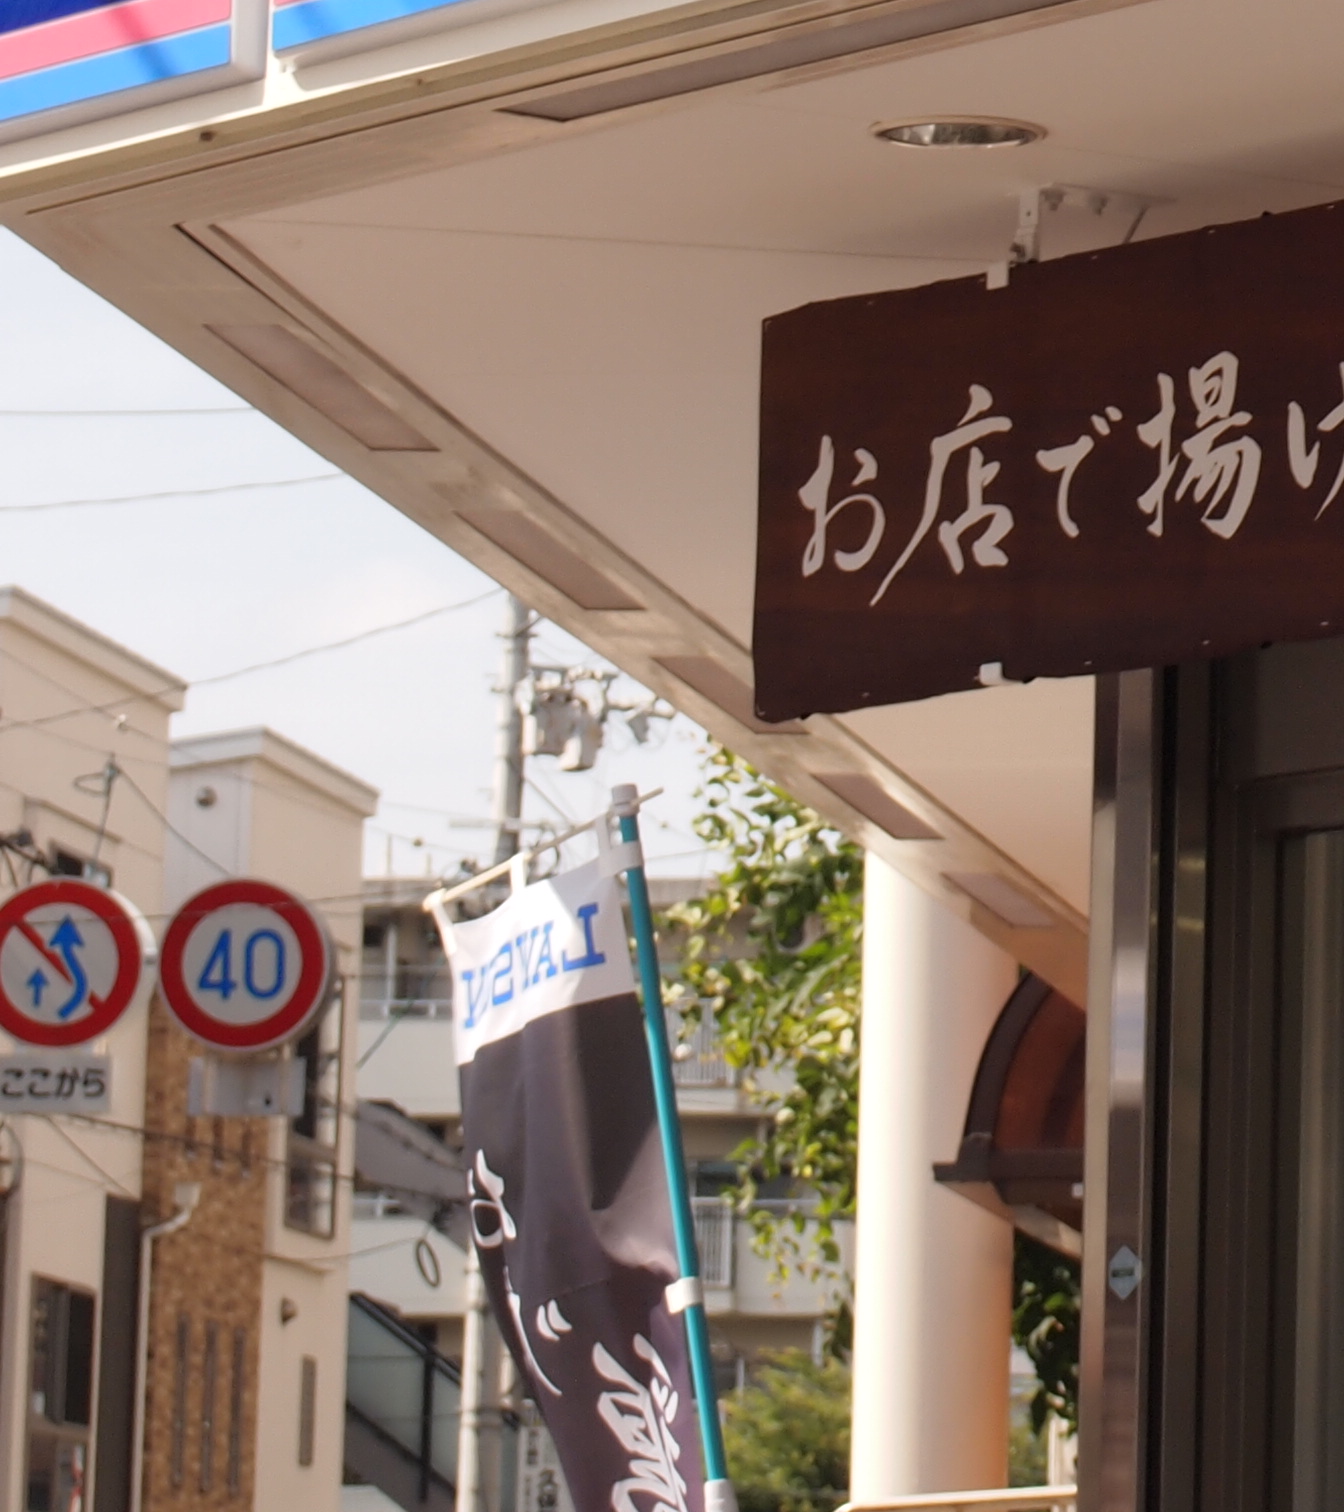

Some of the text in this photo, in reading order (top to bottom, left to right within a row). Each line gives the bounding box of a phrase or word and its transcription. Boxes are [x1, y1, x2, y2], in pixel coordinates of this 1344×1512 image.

[199, 929, 287, 1001] 40
[1, 1066, 106, 1099] ここから
